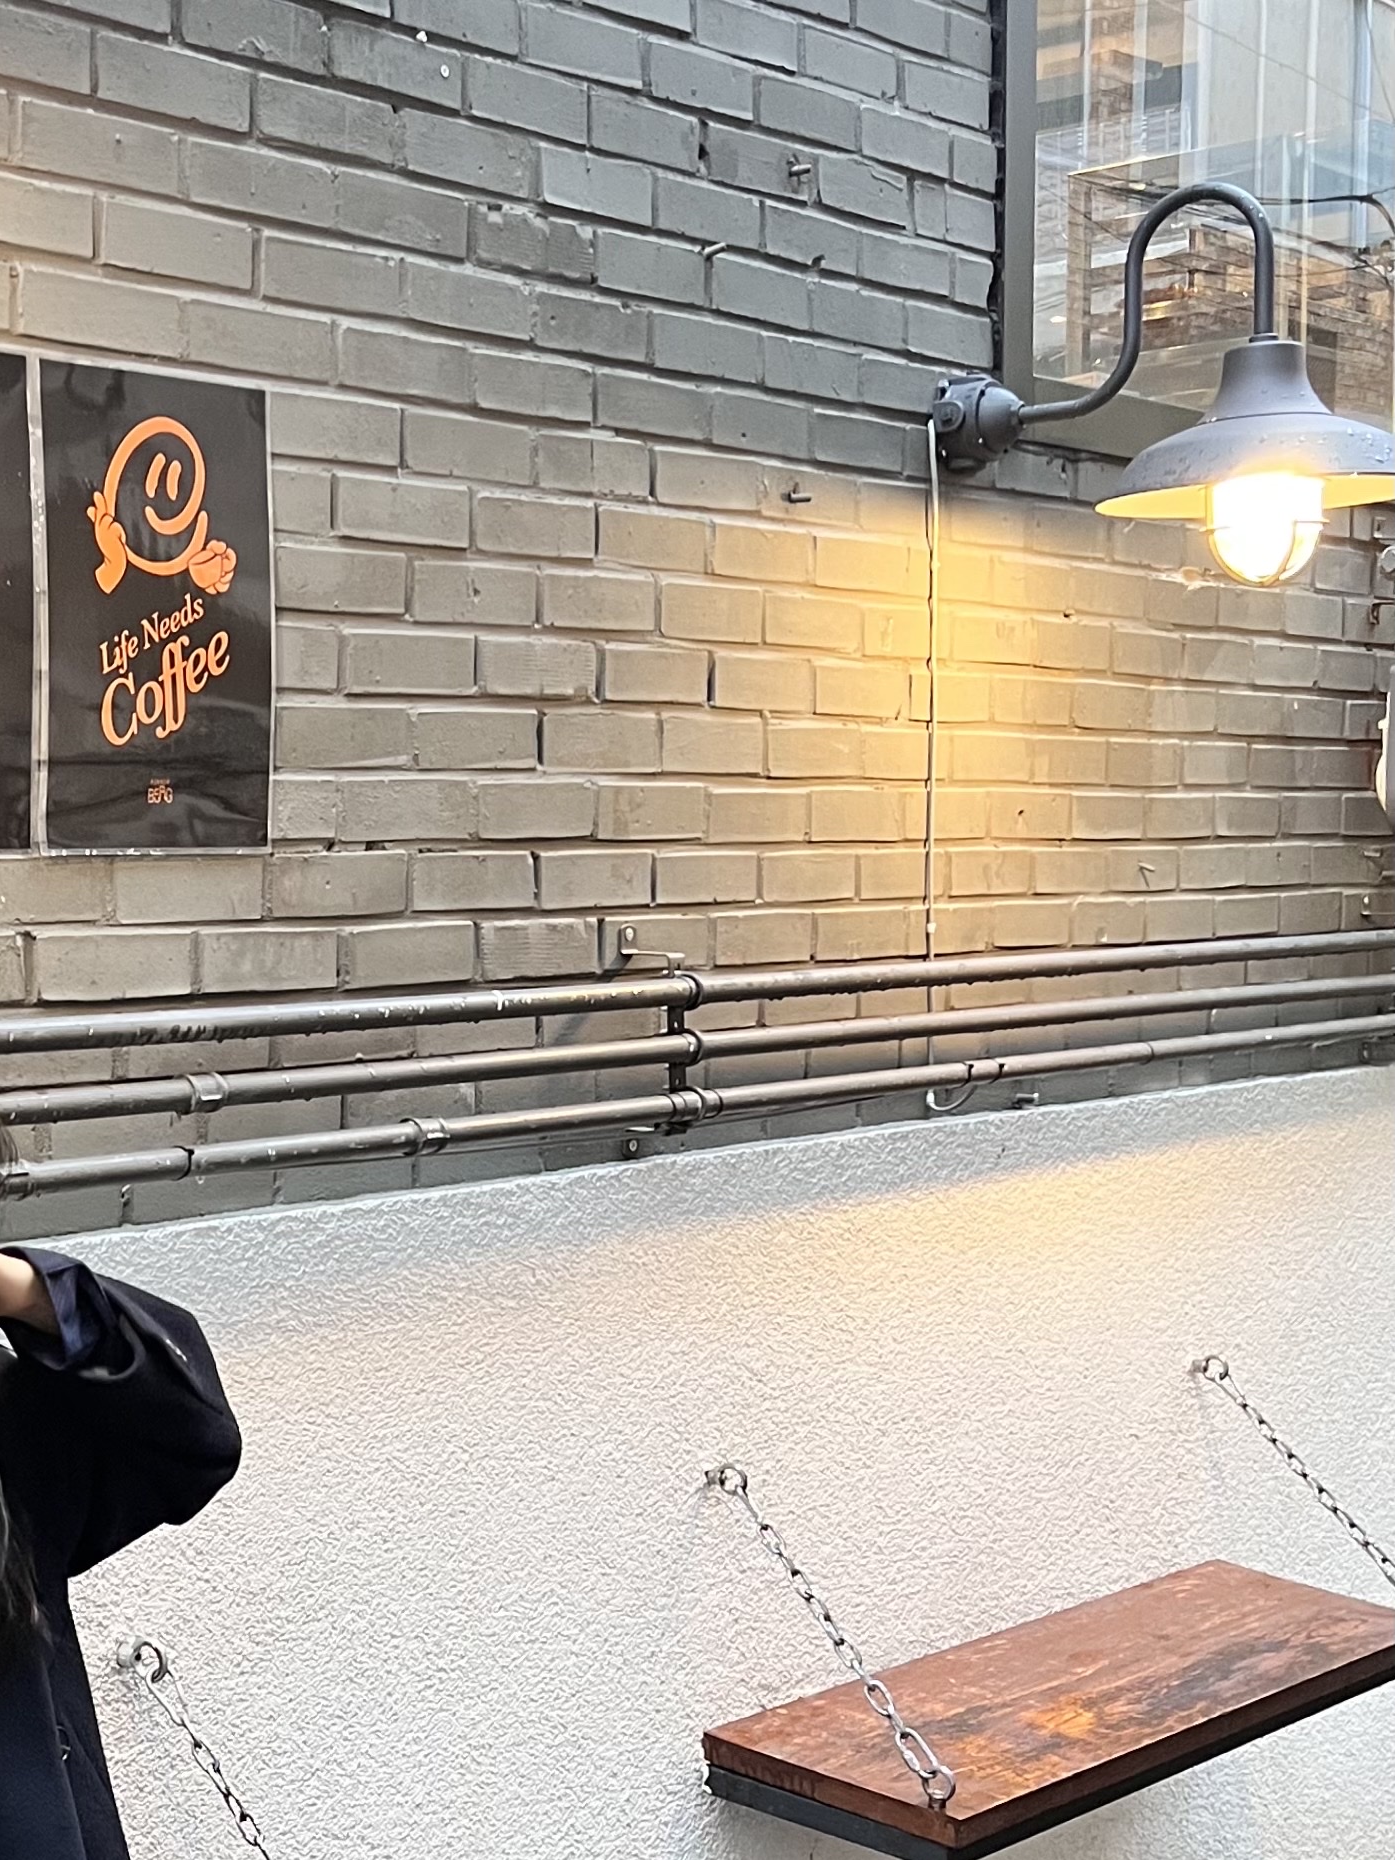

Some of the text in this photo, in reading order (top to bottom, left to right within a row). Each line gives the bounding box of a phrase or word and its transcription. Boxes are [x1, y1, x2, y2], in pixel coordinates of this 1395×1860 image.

[99, 592, 205, 675] Life Needs
[100, 630, 231, 747] Coffee
